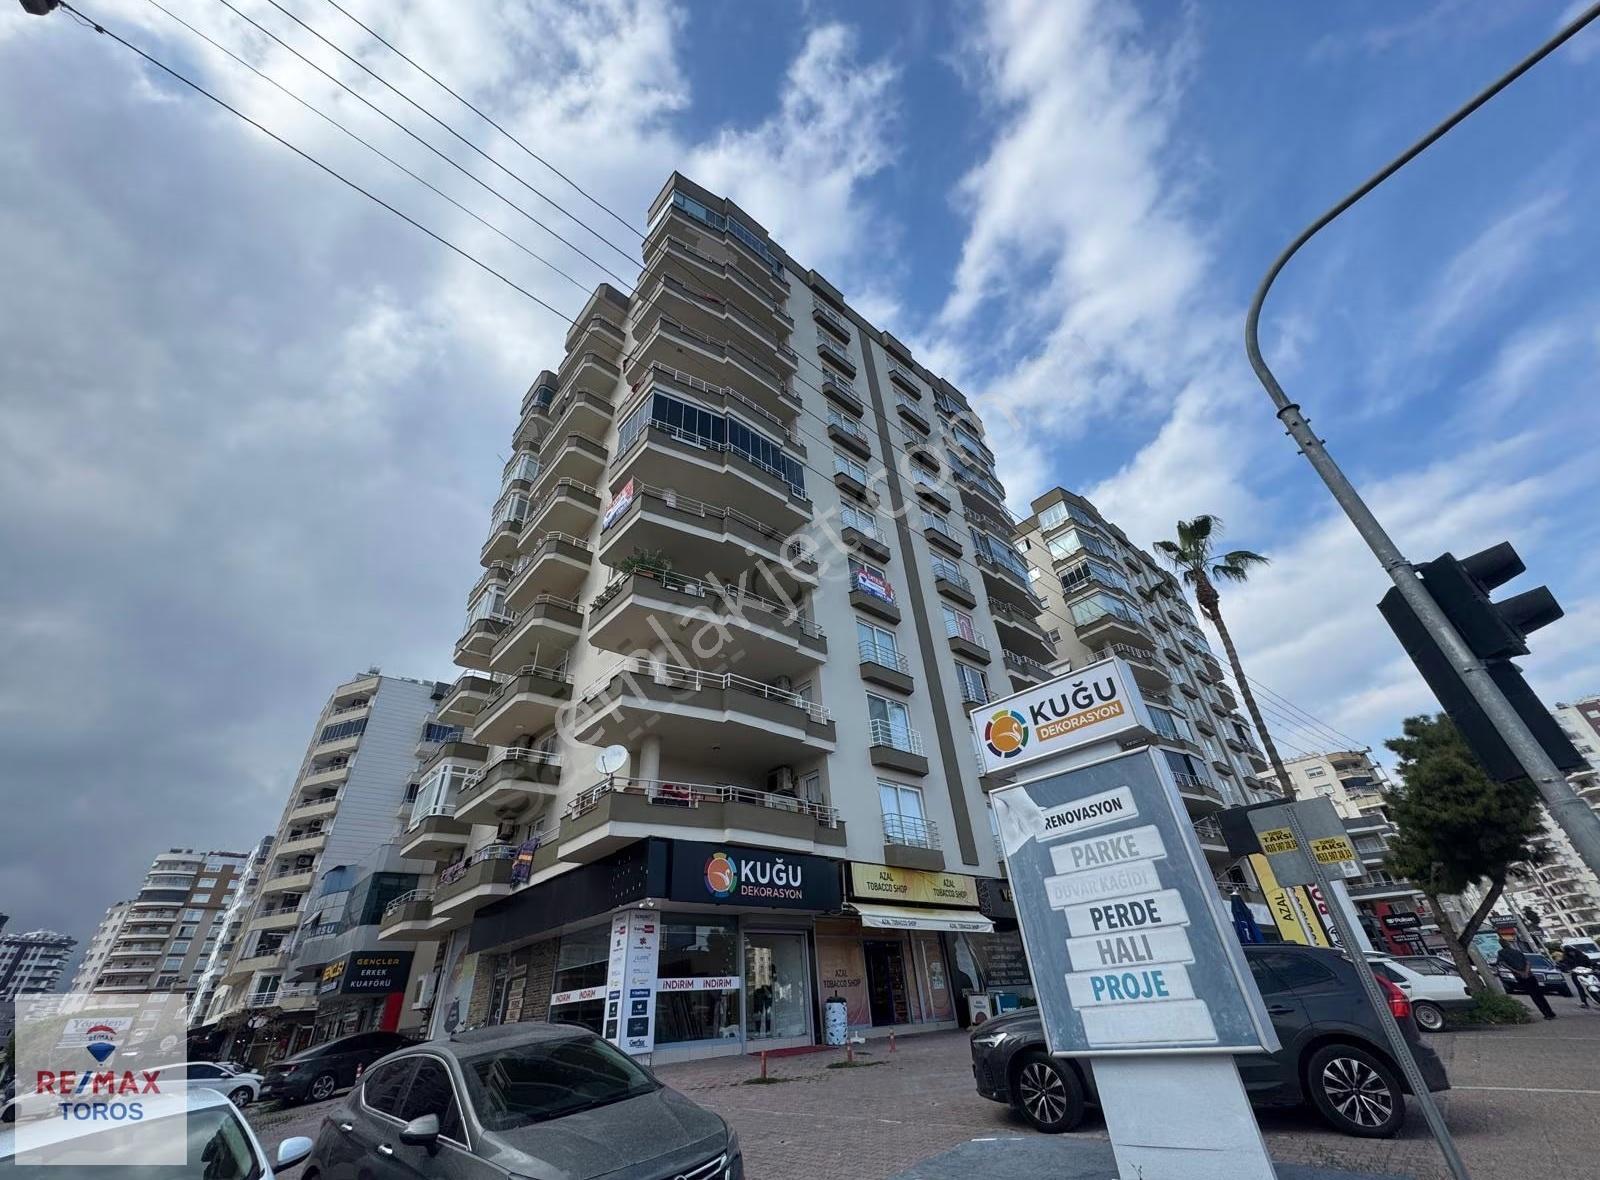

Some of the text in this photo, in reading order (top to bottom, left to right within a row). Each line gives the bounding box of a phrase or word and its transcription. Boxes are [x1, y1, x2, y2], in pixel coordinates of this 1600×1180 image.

[1029, 677, 1117, 726] KUĞU
[1040, 703, 1120, 738] DEKORASYON
[1045, 797, 1122, 830] RENOVASYON
[1071, 834, 1139, 867] PARKE
[741, 857, 802, 887] KUĞU
[880, 872, 893, 881] AZAL
[943, 879, 955, 888] AZAL
[741, 885, 802, 899] DEKORASYON
[867, 881, 908, 894] TOBACCO SHOP
[933, 888, 955, 897] TOBACCO
[1090, 898, 1162, 931] PERDE
[1275, 893, 1294, 921] AZAL
[1096, 934, 1154, 965] HALI
[1090, 970, 1169, 1001] PROJE
